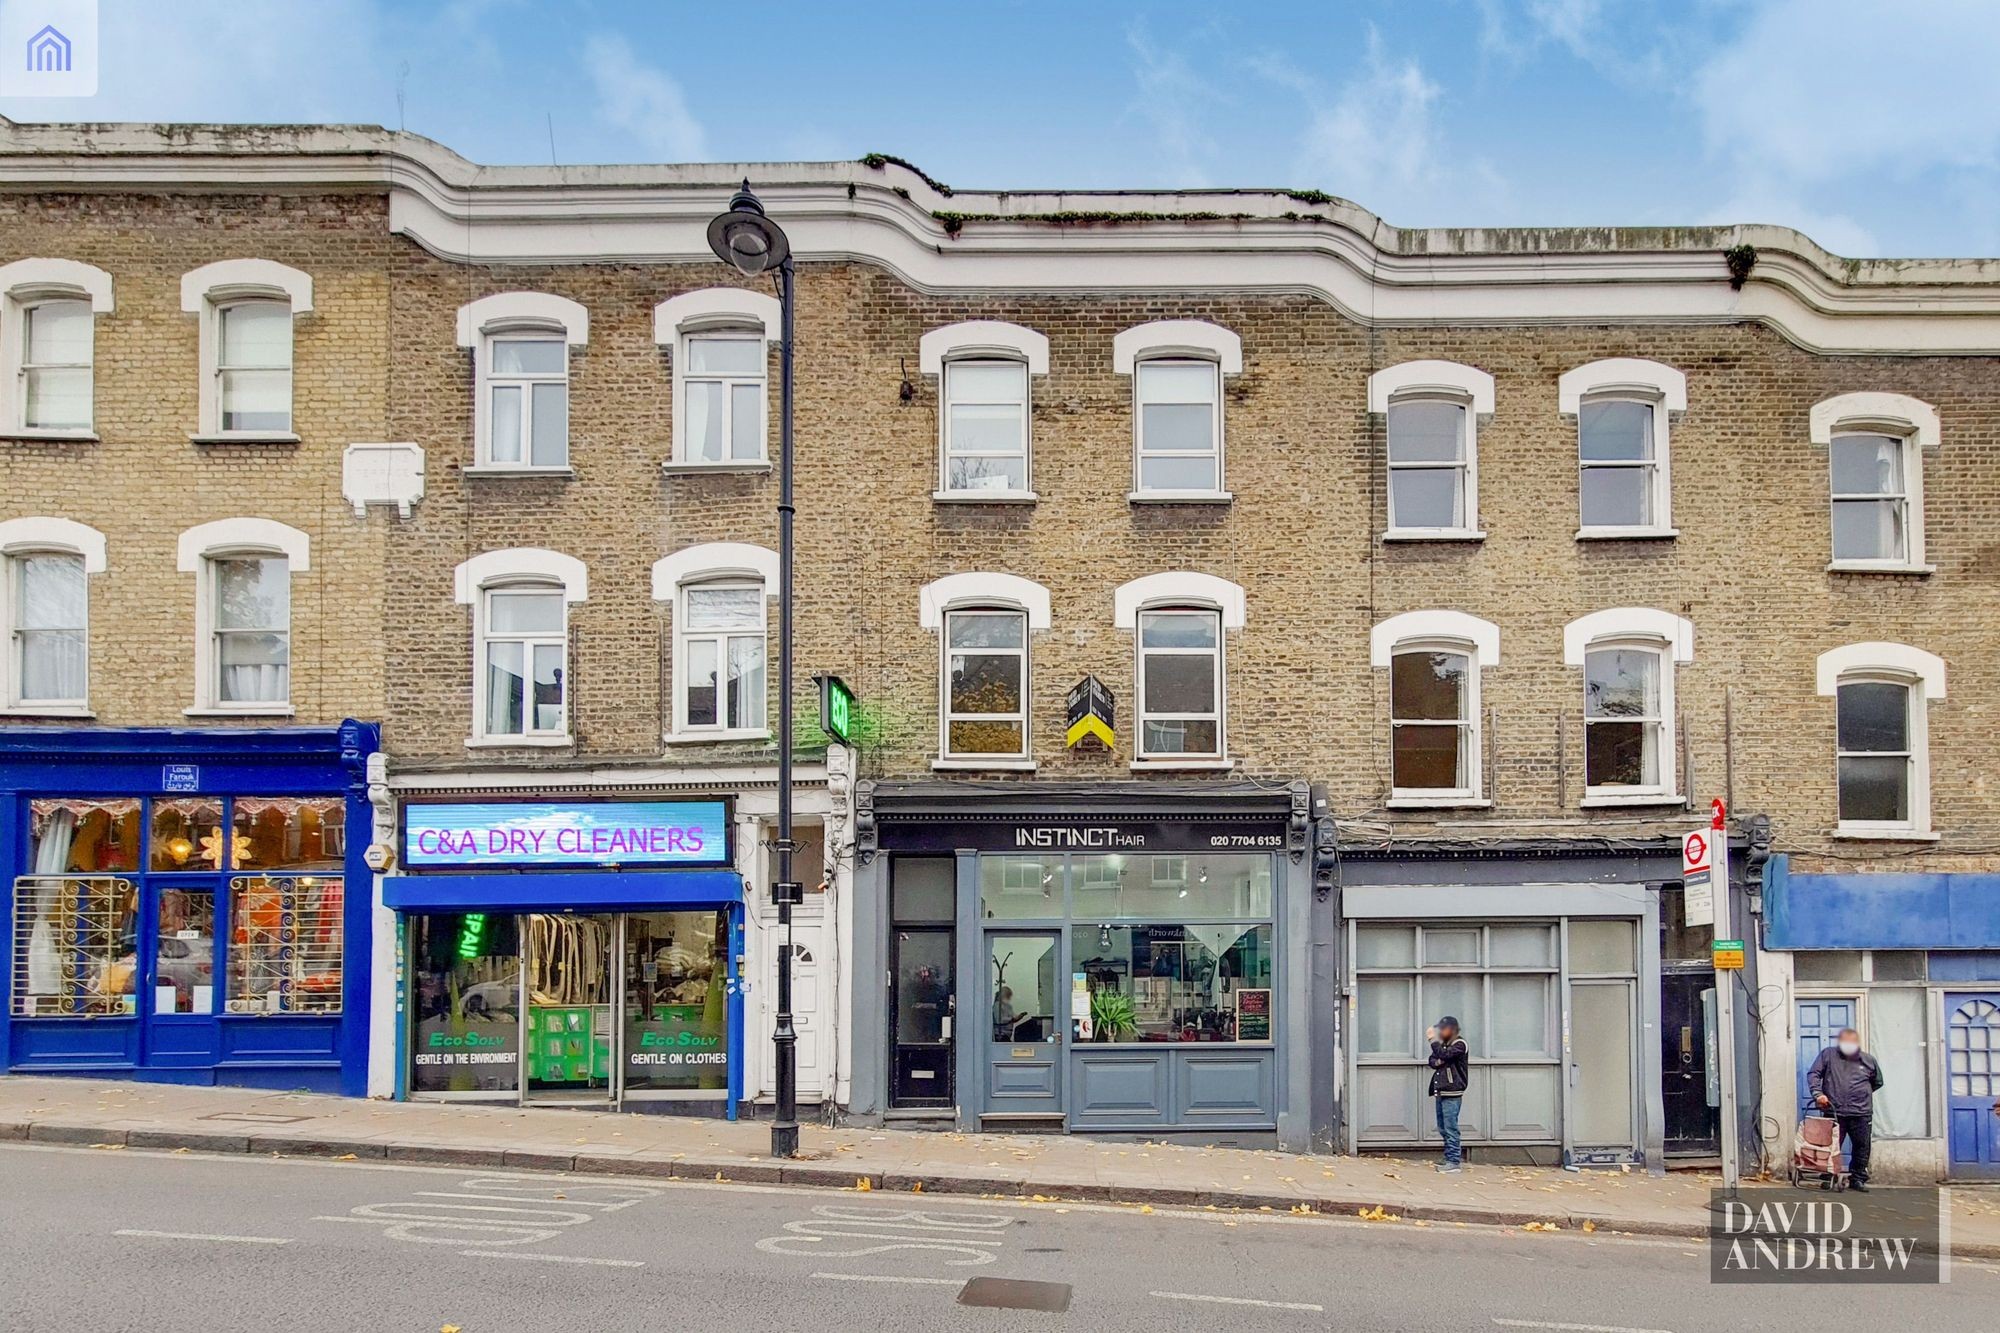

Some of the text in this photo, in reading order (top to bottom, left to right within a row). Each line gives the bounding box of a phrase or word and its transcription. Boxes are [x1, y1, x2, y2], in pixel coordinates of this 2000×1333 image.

[418, 827, 704, 855] C&A DRY CLEANERS
[1016, 828, 1282, 846] INSTINCT HAIR 020 7704 6135
[415, 1052, 517, 1065] GENTLE ON THE ENVIRONMENT
[631, 1052, 728, 1065] GENTLE ON CLOTHES
